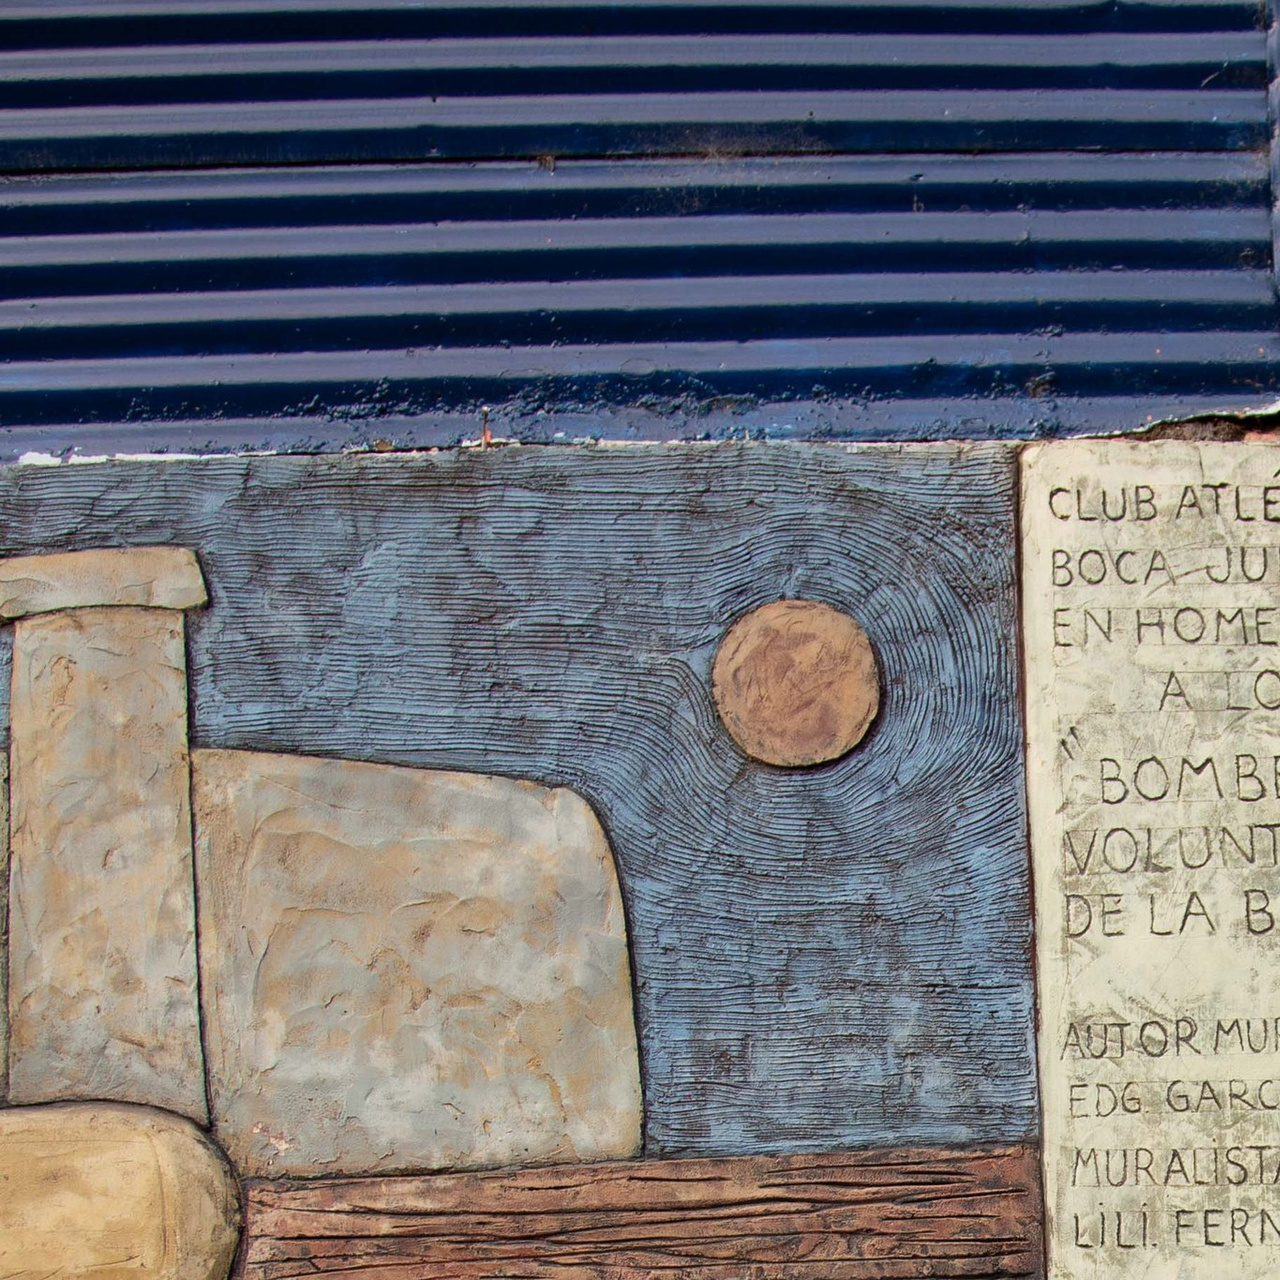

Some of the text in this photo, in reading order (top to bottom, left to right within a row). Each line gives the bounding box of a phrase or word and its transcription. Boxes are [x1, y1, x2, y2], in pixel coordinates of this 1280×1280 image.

[1048, 484, 1158, 522] CLUB
[1051, 548, 1177, 588] BOCA
[1053, 606, 1114, 648] EN
[1158, 670, 1194, 712] A
[1065, 892, 1126, 939] DE
[1149, 891, 1217, 937] LA
[1060, 1016, 1202, 1061] AUTOR
